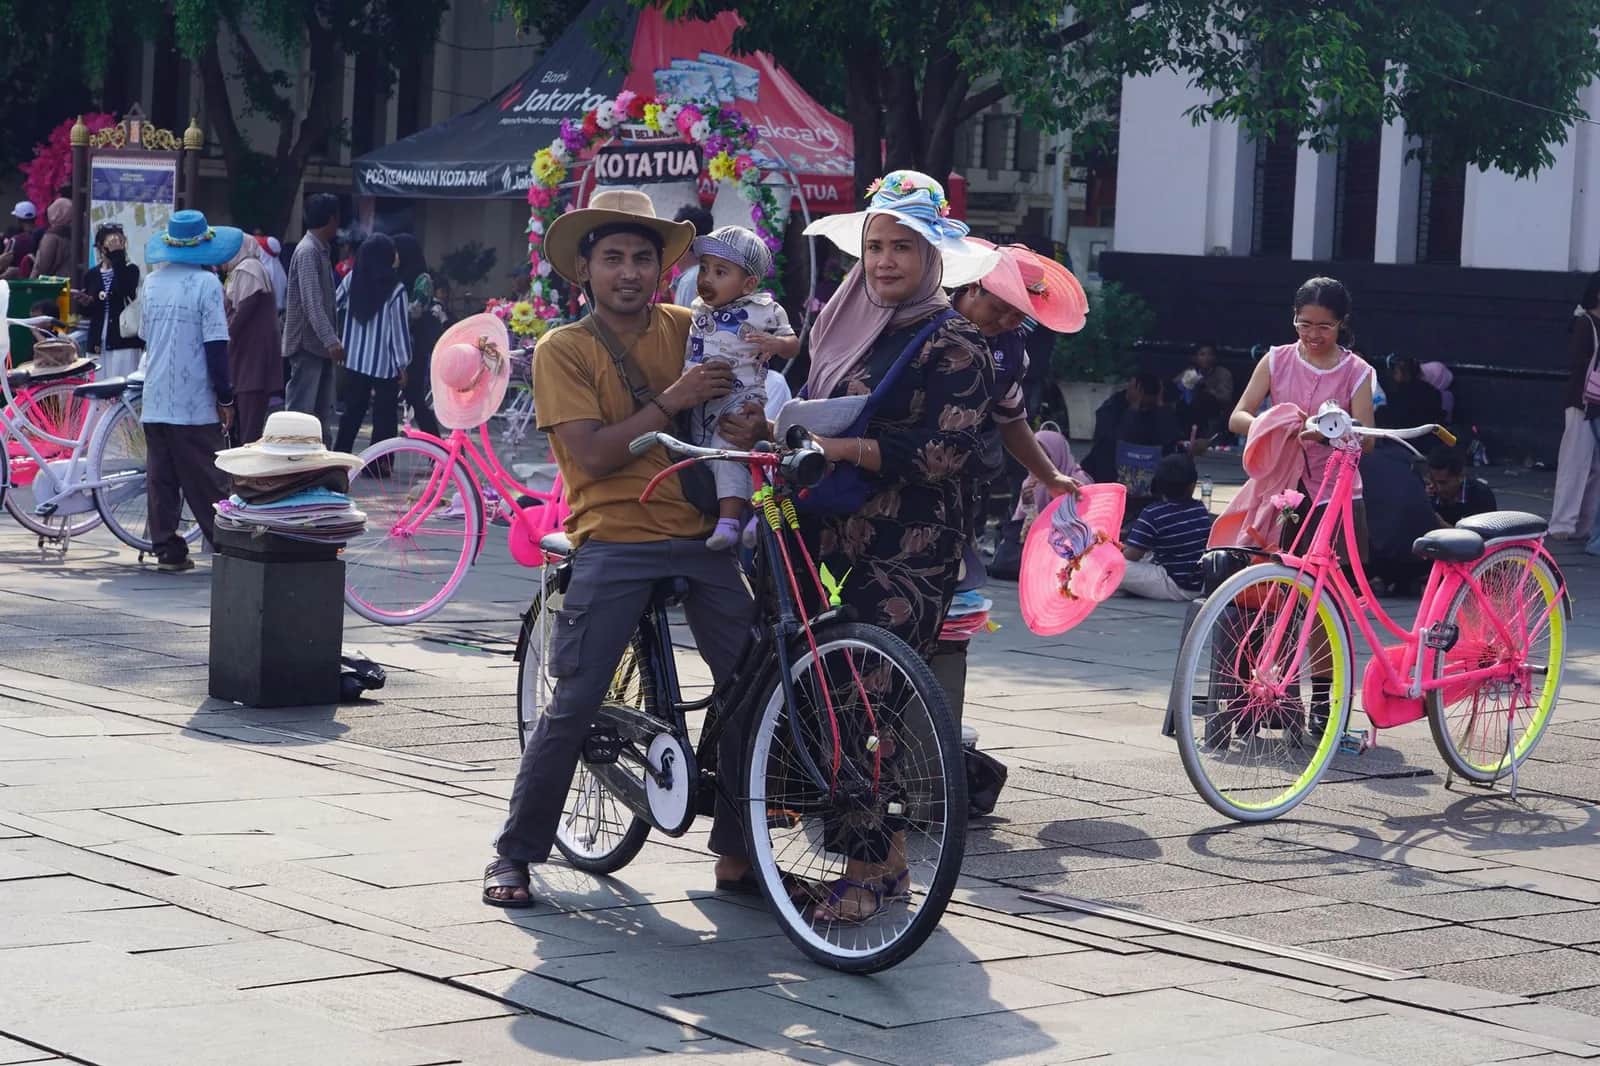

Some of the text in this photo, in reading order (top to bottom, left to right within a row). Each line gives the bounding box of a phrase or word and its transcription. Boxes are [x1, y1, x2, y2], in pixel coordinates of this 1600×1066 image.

[513, 87, 607, 112] Jakarta
[752, 115, 839, 149] akcard
[384, 168, 438, 186] KEAMANAN
[439, 169, 466, 187] KOTA
[467, 169, 488, 187] TUA
[803, 183, 839, 201] TUA
